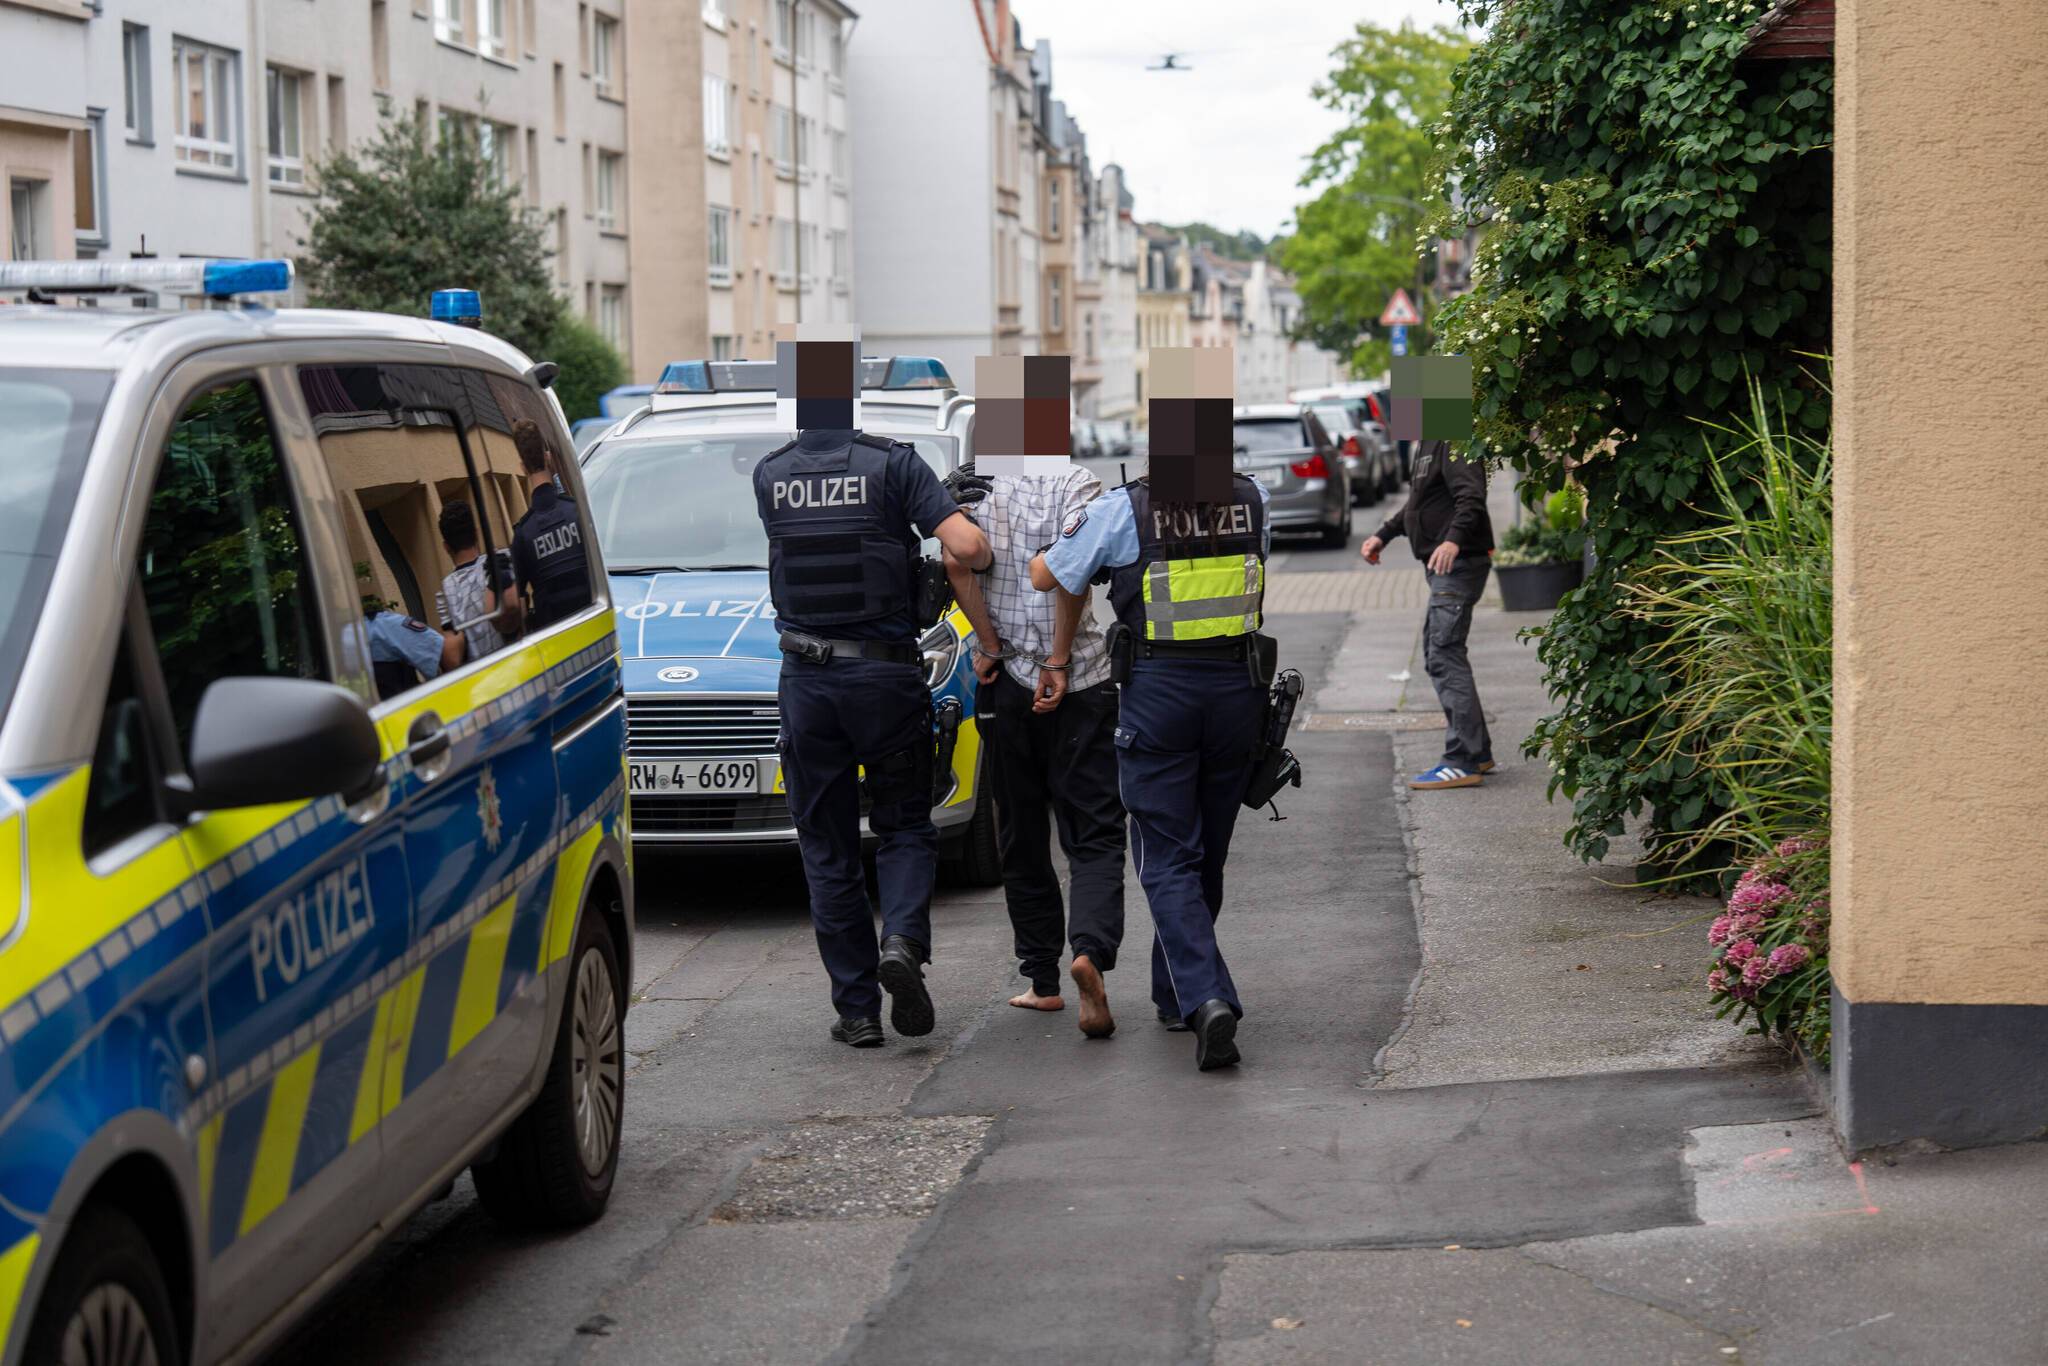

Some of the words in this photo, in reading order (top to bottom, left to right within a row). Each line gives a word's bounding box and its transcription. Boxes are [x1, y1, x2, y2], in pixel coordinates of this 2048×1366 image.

[773, 476, 867, 510] POLIZEI
[1153, 504, 1253, 539] POLZEI
[671, 763, 755, 789] 4-6699
[250, 852, 375, 1003] POLIZEI
